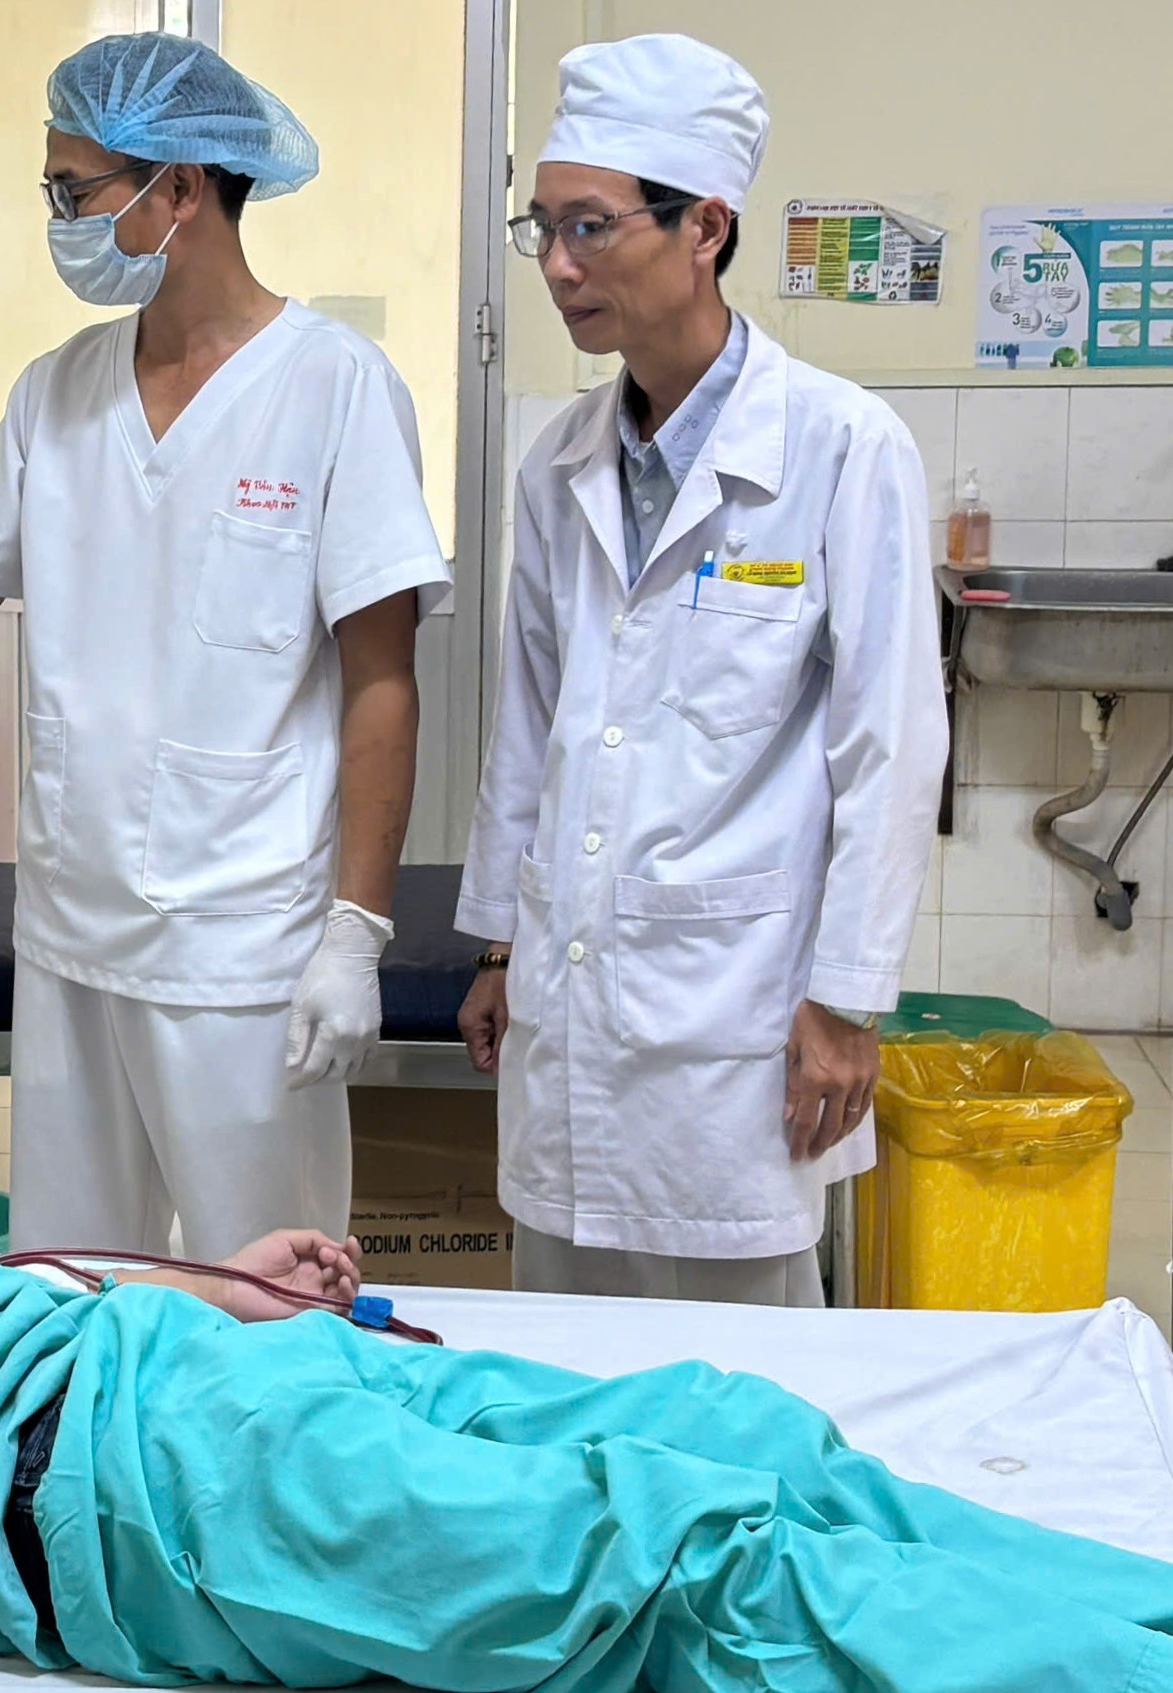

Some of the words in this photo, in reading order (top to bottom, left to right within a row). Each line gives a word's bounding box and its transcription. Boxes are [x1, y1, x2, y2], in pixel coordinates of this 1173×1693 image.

[994, 292, 1001, 303] 2
[1012, 312, 1020, 326] 3
[419, 1233, 498, 1252] CHLORIDE
